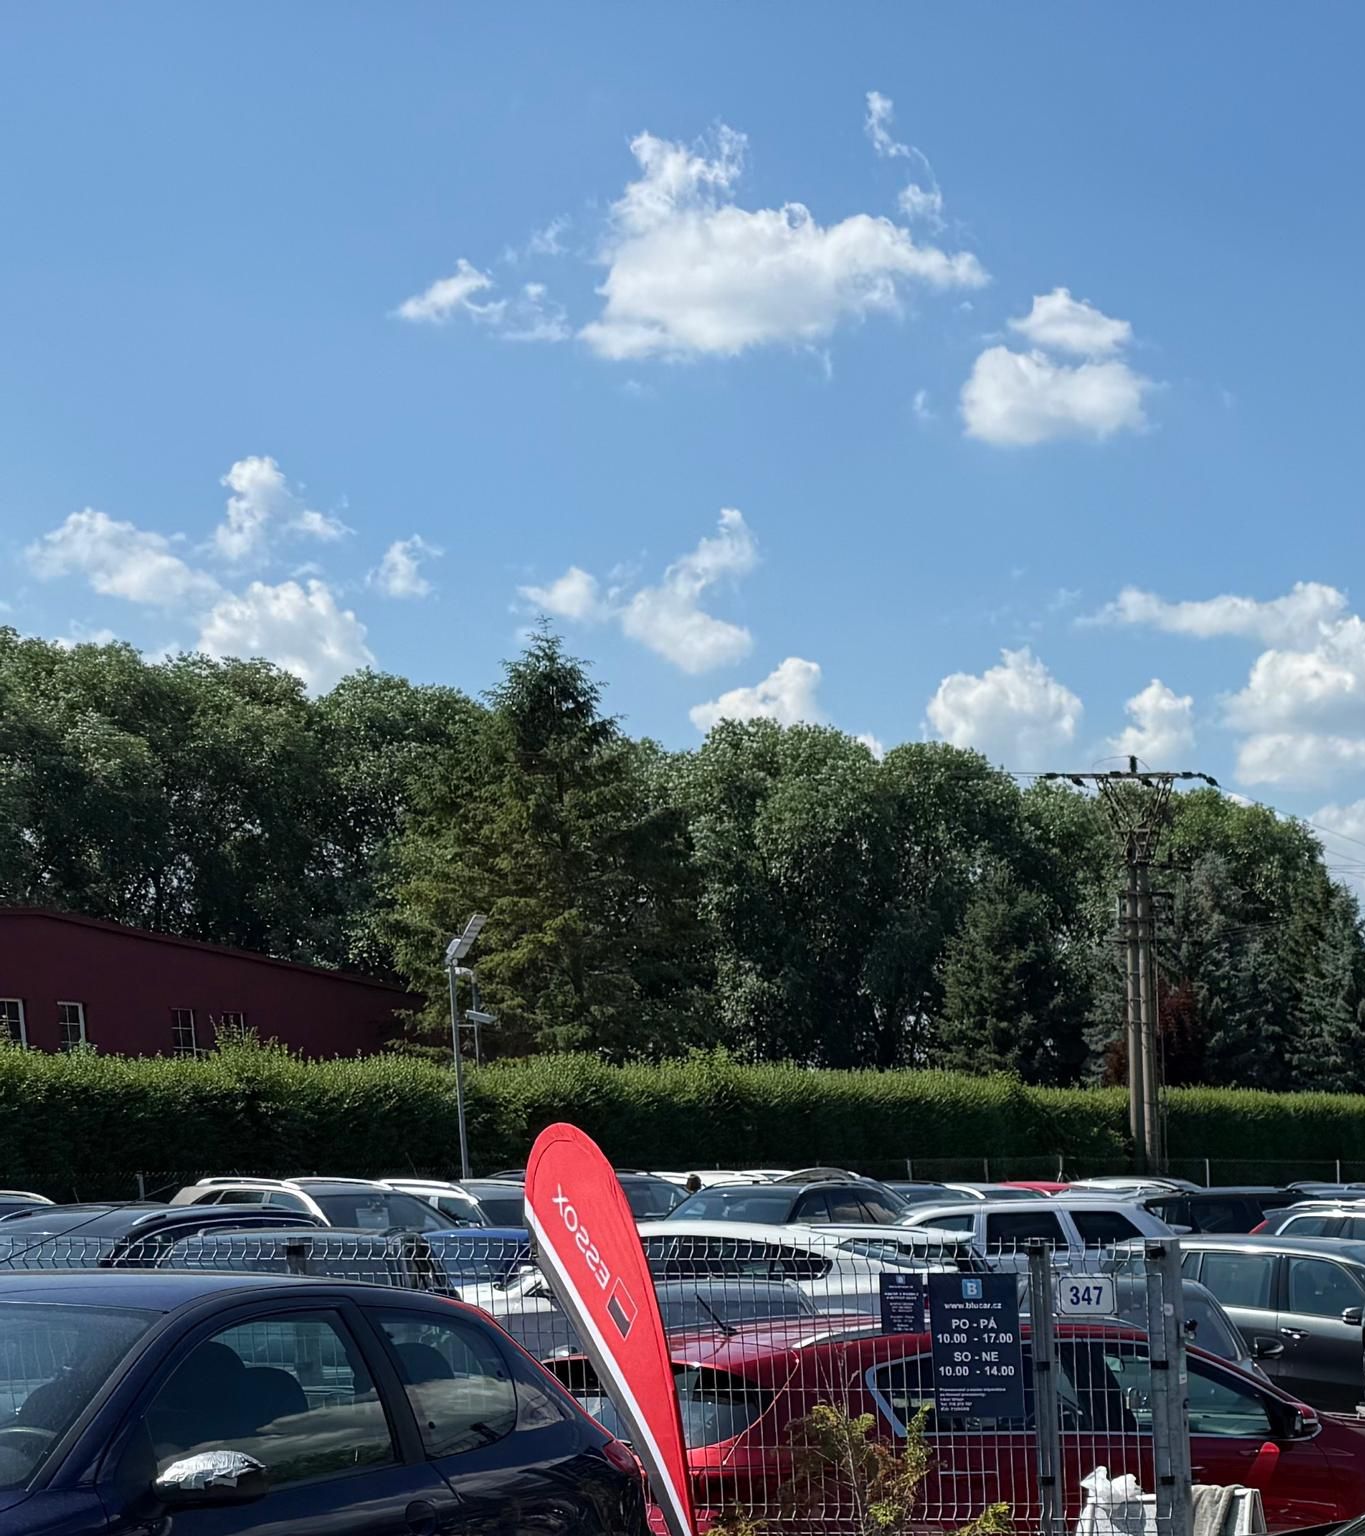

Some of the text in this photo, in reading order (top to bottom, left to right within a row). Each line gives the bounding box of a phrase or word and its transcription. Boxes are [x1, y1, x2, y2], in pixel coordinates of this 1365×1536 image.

[1070, 1285, 1103, 1306] 347
[944, 1302, 1002, 1310] www.blucar.cz
[951, 1319, 970, 1330] PO
[980, 1317, 998, 1330] PÁ
[936, 1333, 968, 1344] 10.00
[982, 1333, 1014, 1344] 17.00
[953, 1351, 972, 1362] SO
[981, 1351, 999, 1362] NE
[938, 1365, 970, 1376] 10.00
[984, 1365, 1015, 1376] 14.00
